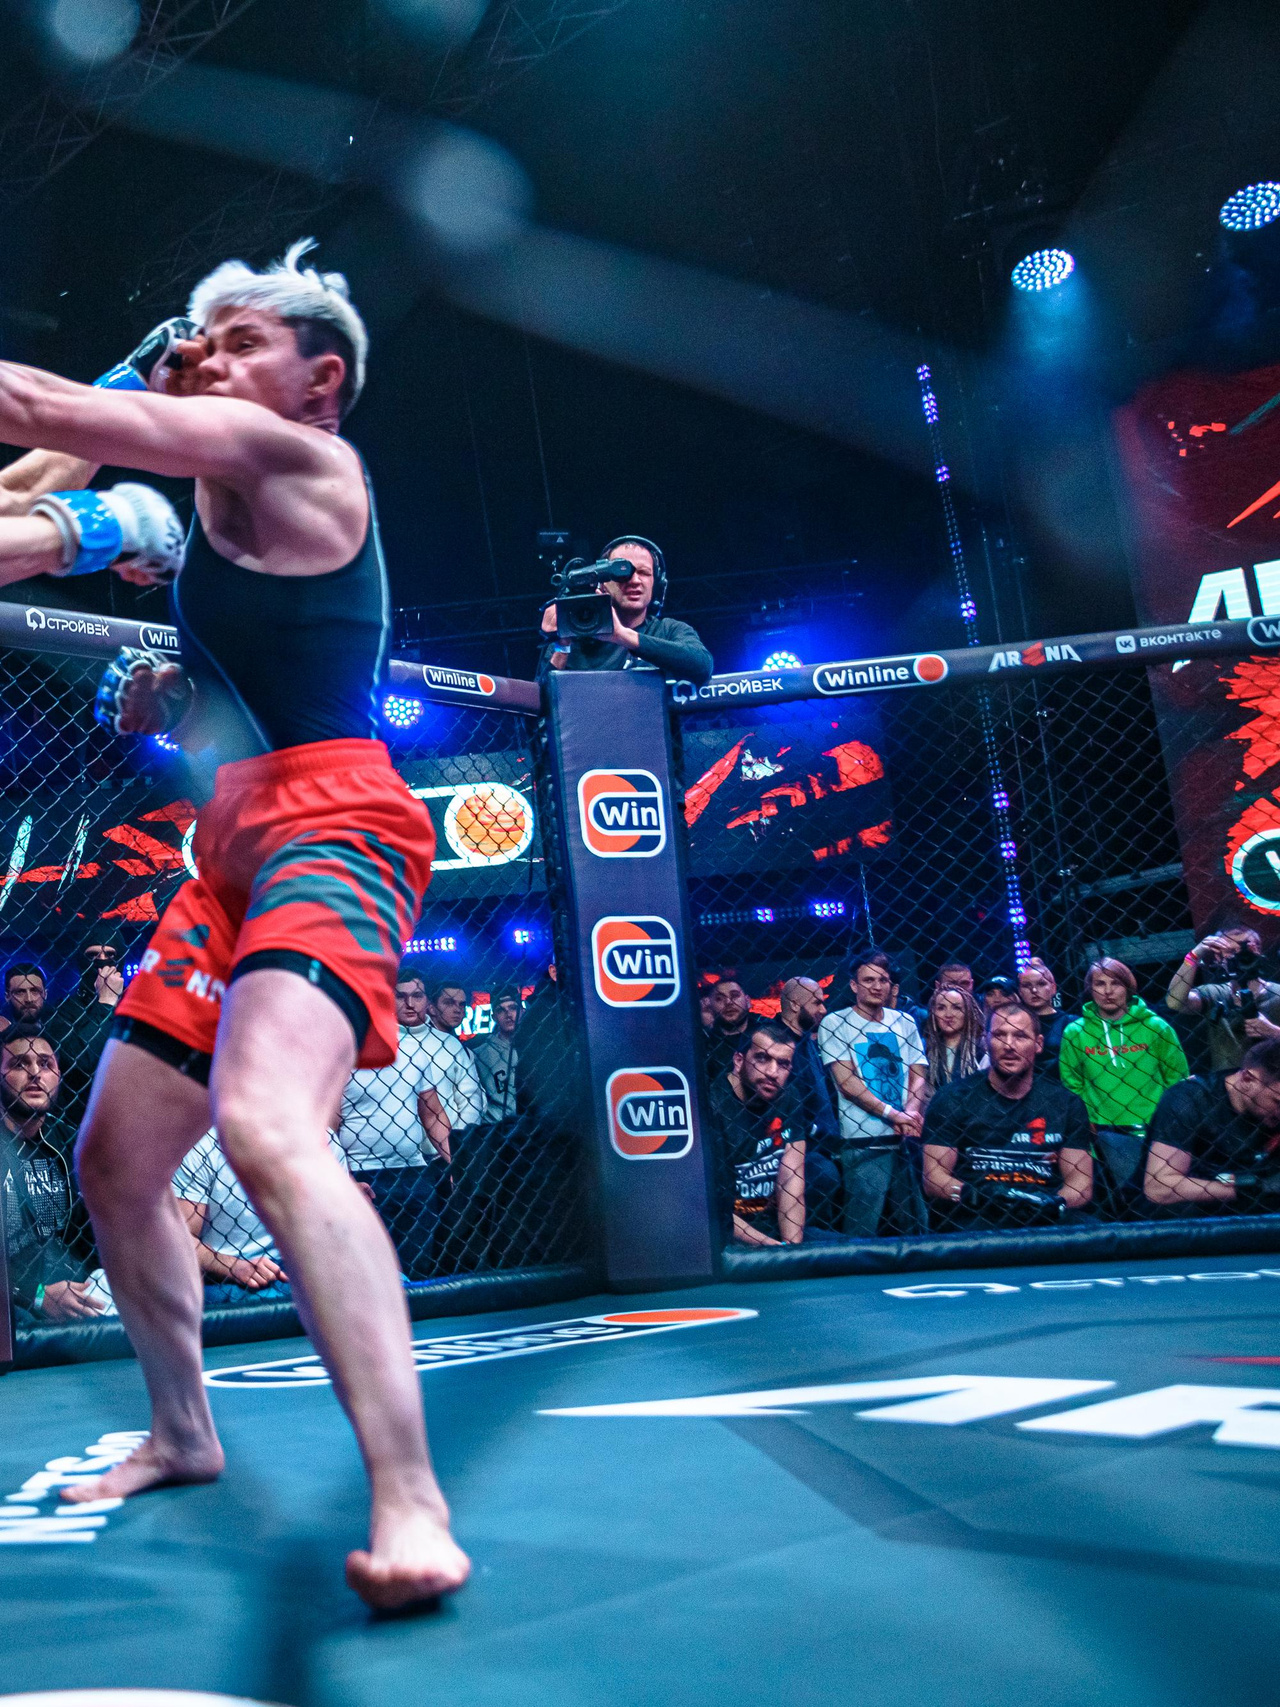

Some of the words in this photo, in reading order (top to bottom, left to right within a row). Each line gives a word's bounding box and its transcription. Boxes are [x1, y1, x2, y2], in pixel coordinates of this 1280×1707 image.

[46, 617, 110, 637] СТРОЙВЕК
[988, 641, 1083, 673] ARENA
[429, 668, 477, 688] Winline
[699, 677, 784, 699] СТРОЙВЕК
[825, 664, 910, 688] Winline
[598, 801, 658, 826] Win
[613, 949, 672, 975] Win
[626, 1100, 685, 1126] Win
